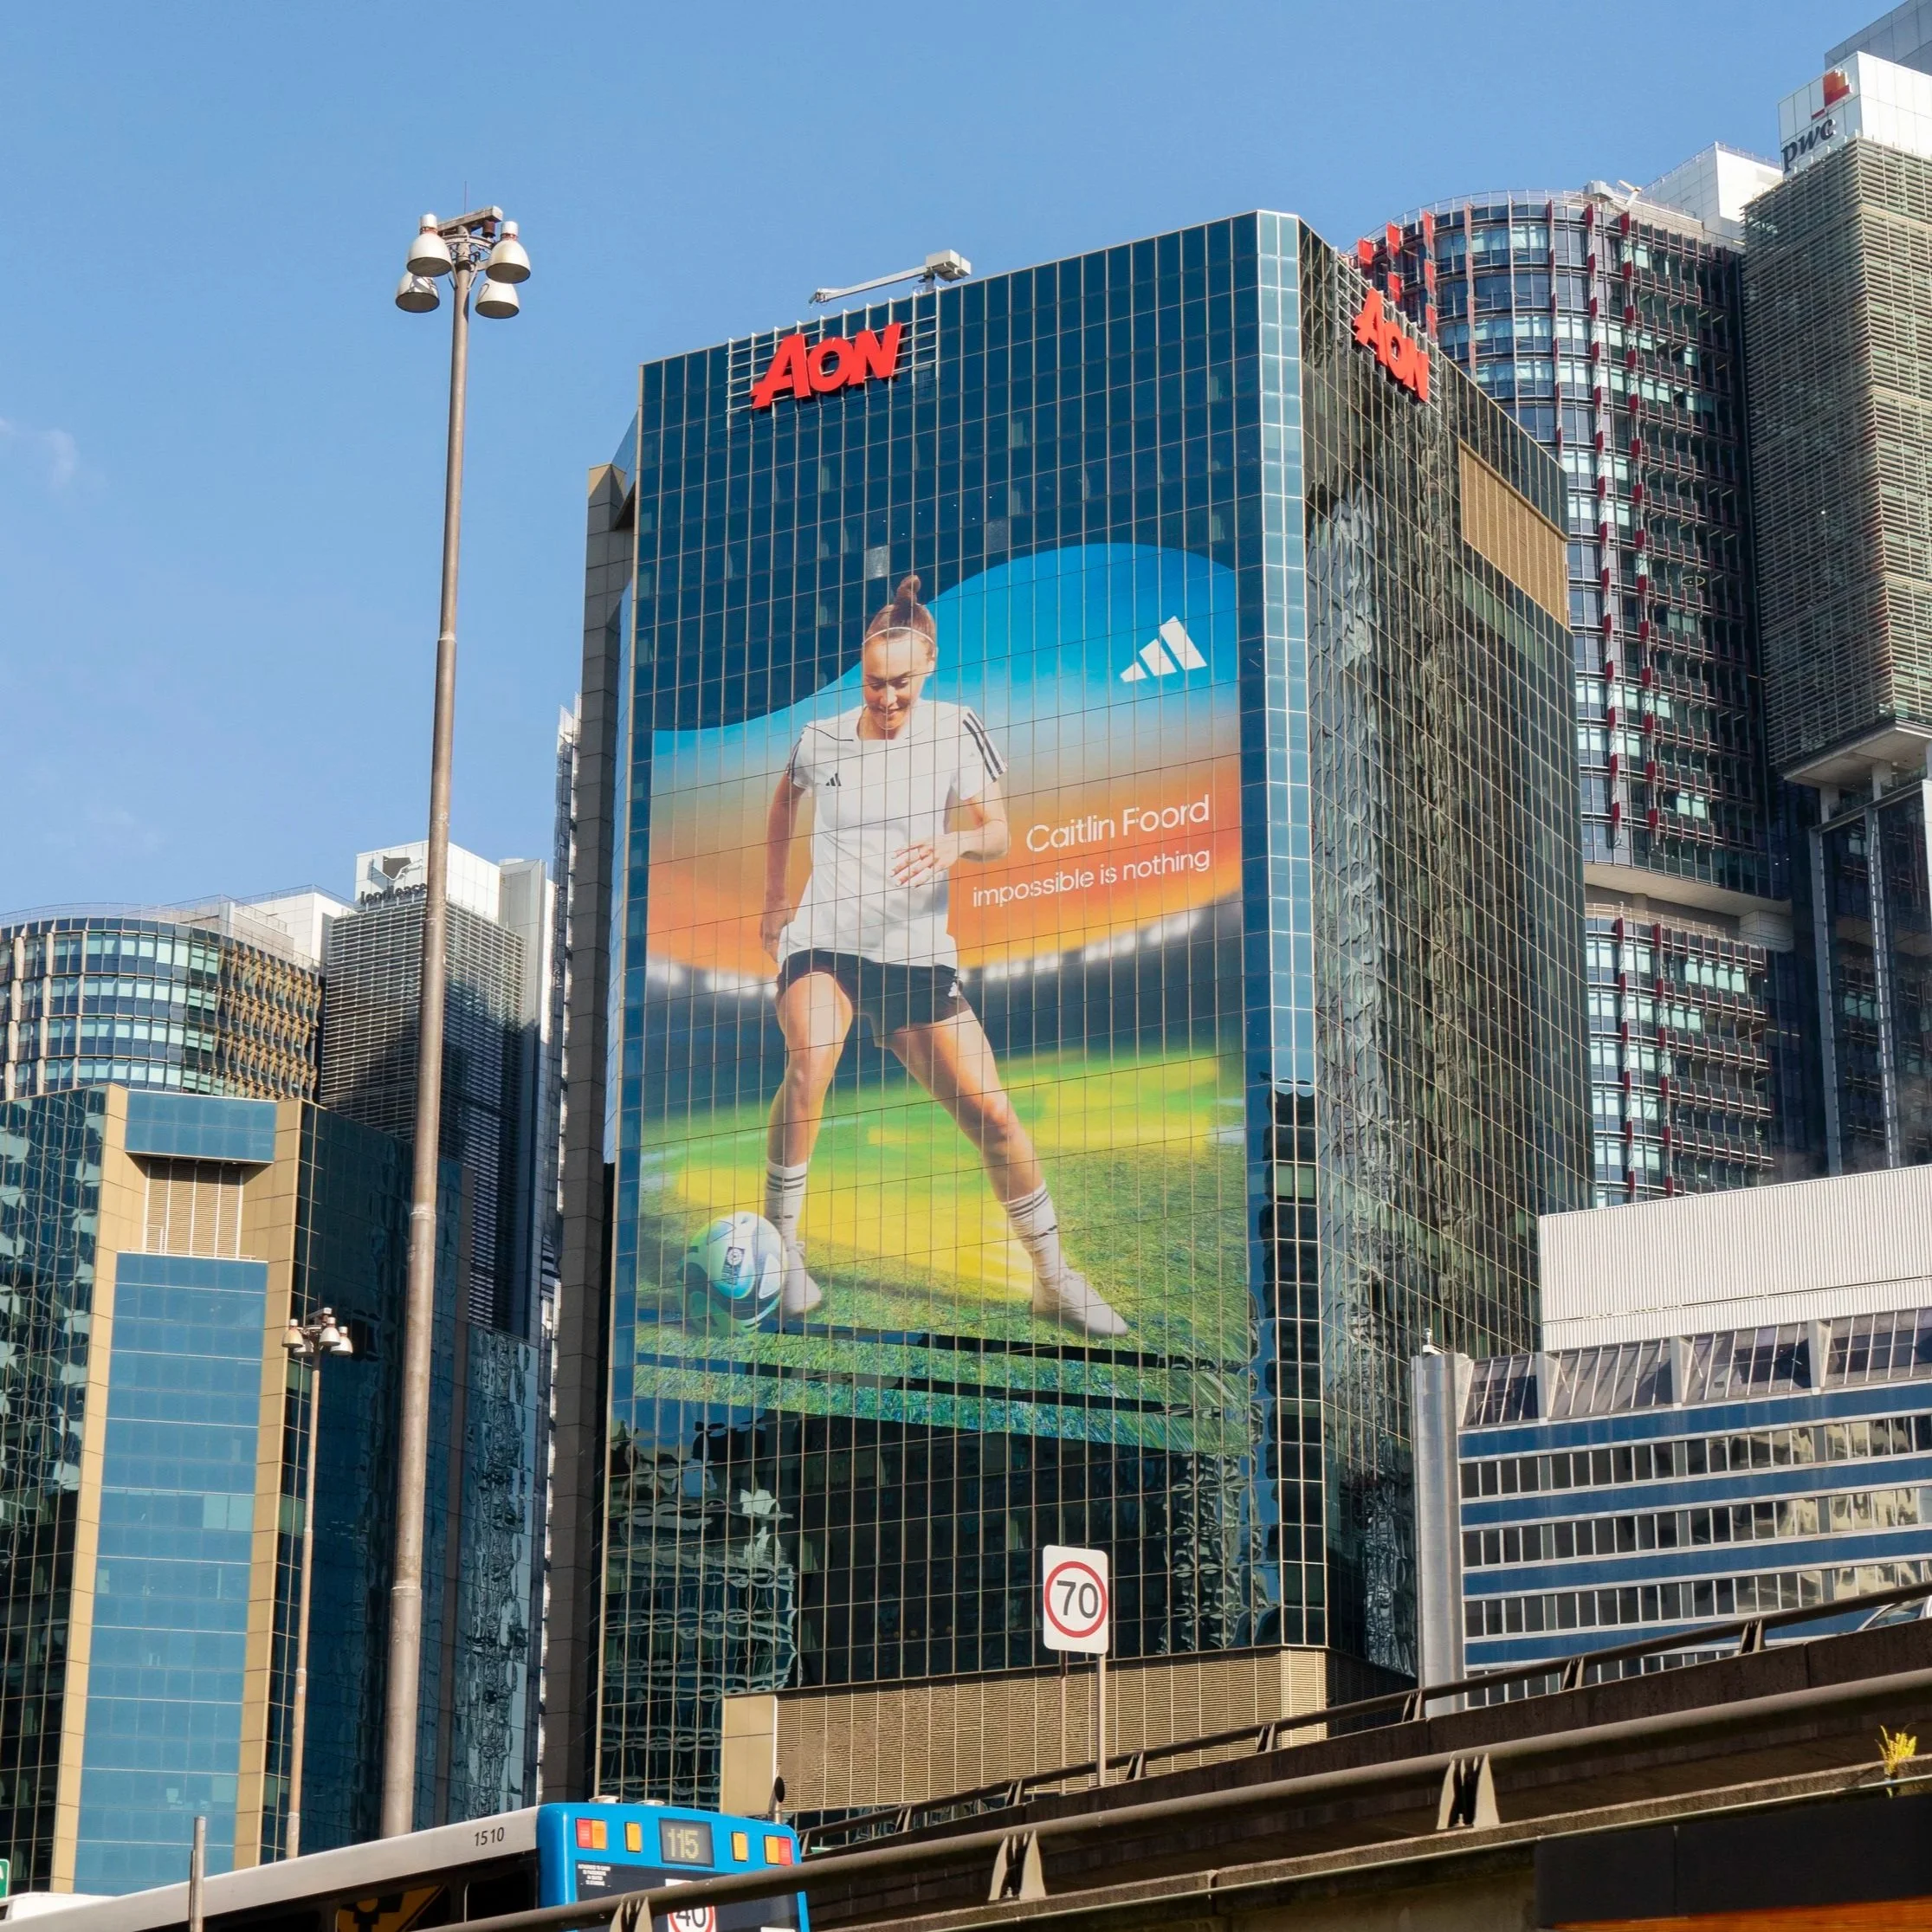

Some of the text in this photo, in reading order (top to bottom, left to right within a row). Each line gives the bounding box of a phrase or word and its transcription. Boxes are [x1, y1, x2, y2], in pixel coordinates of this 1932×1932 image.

[1780, 119, 1834, 173] pwc
[750, 321, 902, 410] AON
[1354, 286, 1429, 403] AON
[1026, 793, 1210, 852] Caitlin Foord
[360, 882, 428, 906] lendlease
[972, 850, 1210, 908] impossible is nothing
[1056, 1580, 1099, 1619] 70
[474, 1826, 505, 1847] 1510
[667, 1828, 700, 1859] 115
